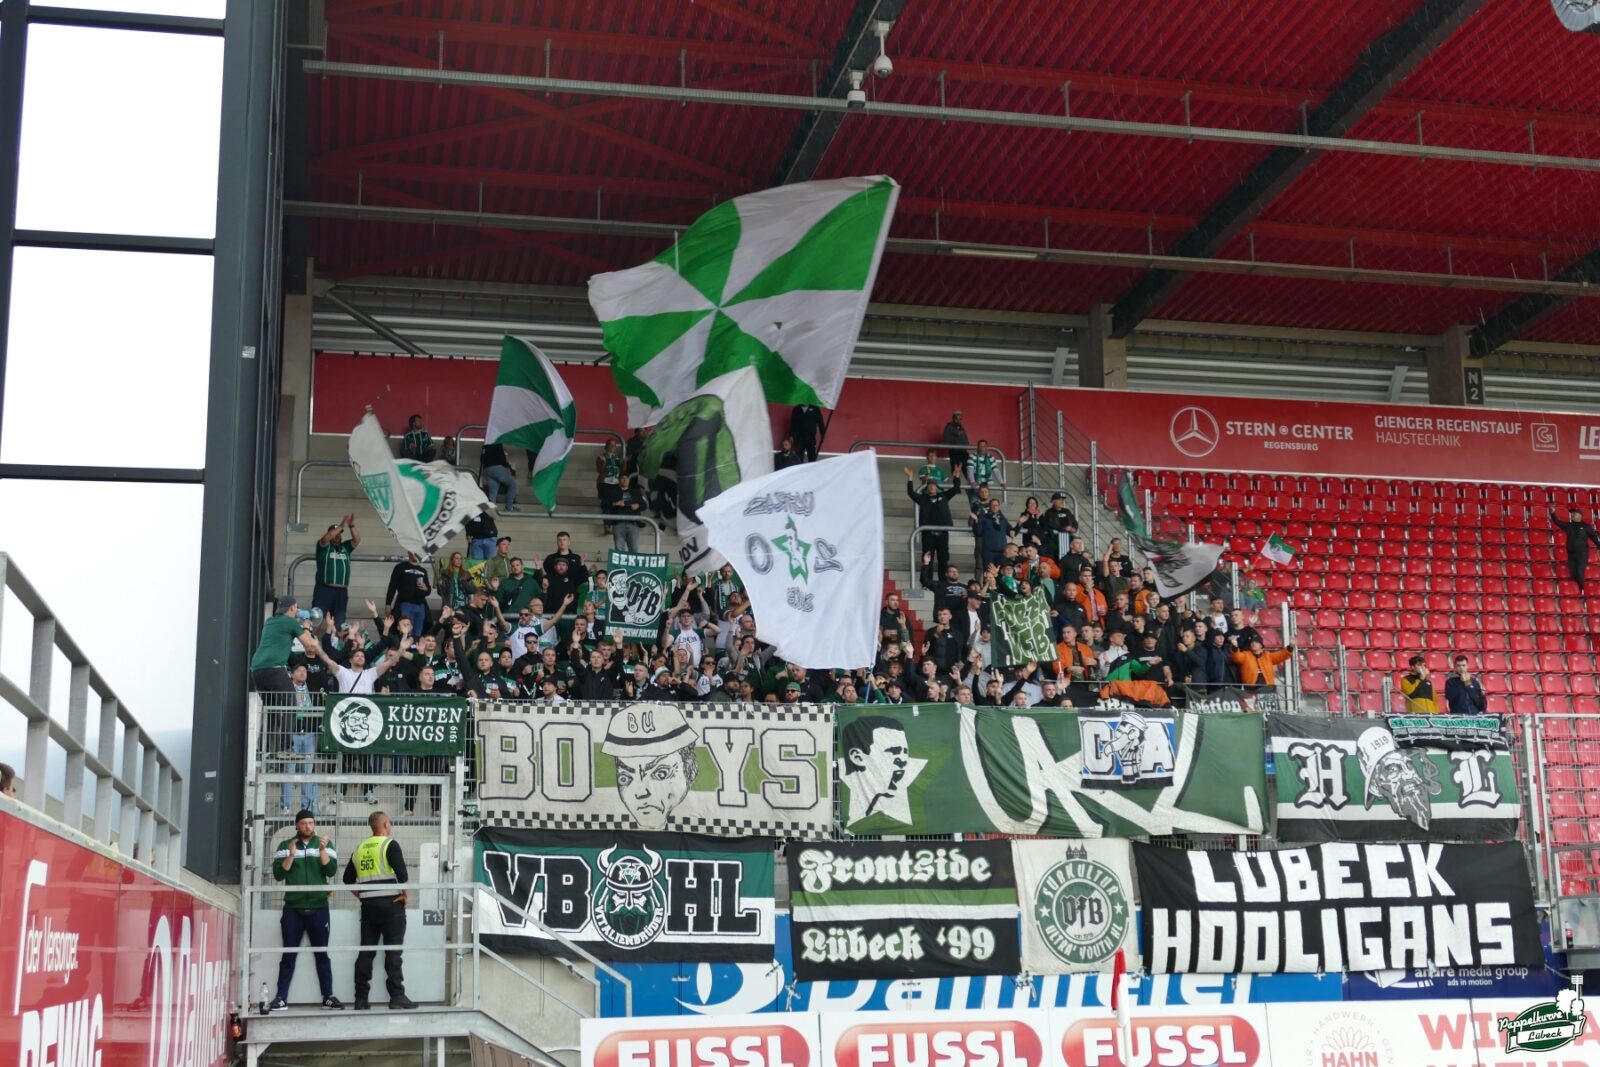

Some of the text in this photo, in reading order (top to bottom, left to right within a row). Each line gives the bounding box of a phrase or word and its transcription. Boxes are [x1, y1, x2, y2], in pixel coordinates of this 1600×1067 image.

[1468, 372, 1479, 385] N
[1470, 387, 1479, 400] 2
[1225, 421, 1354, 440] STERN CENTER
[1375, 415, 1523, 435] GIENGER REGENSTAUF
[1264, 441, 1319, 451] REGENSBURG
[1376, 431, 1461, 448] HAUSTECHNIK
[611, 552, 666, 568] SEKTION
[388, 704, 463, 724] KÜSTEN
[627, 711, 656, 734] BU
[385, 725, 445, 742] JUNGS
[450, 725, 458, 743] 1919
[1370, 734, 1391, 751] 1919
[360, 859, 375, 871] 563
[1187, 841, 1455, 903] LÜBECK
[1042, 863, 1119, 898] SUBKULTUR
[595, 905, 664, 946] VITALIENBRÜDER
[802, 924, 925, 963] Lübeck
[1151, 902, 1516, 973] HOOLIGANS
[1459, 966, 1492, 977] media
[1495, 967, 1529, 980] group
[1468, 978, 1493, 986] motion
[1312, 1010, 1375, 1035] HANDWERK
[617, 1035, 795, 1067] FUSSL
[857, 1031, 1028, 1067] FUSSL
[1082, 1024, 1247, 1067] FUSSL
[1321, 1051, 1379, 1067] HAHN
